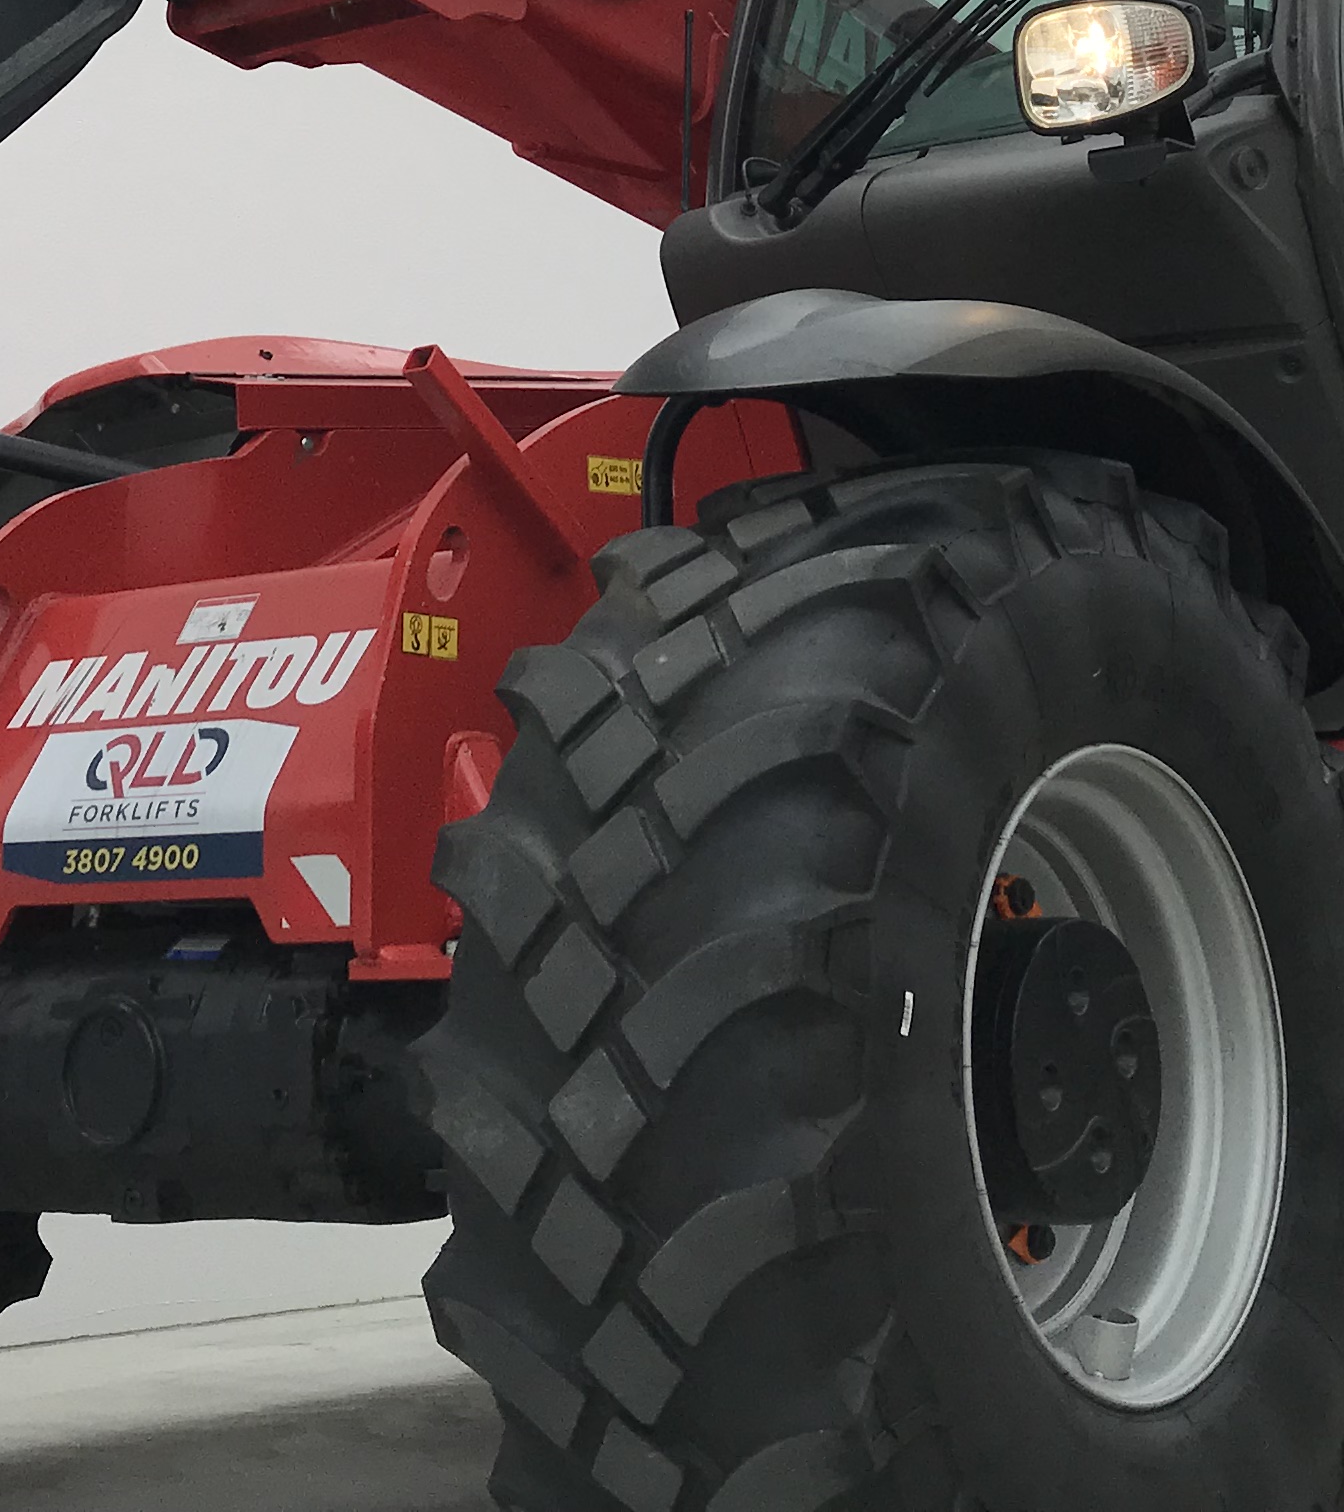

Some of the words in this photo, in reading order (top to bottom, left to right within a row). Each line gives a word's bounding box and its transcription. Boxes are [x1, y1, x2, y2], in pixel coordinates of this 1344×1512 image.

[6, 628, 379, 730] MANITOU
[85, 727, 231, 799] QLD
[67, 798, 201, 825] FORKLIFTS
[62, 846, 126, 875] 3807
[131, 843, 200, 872] 4900
